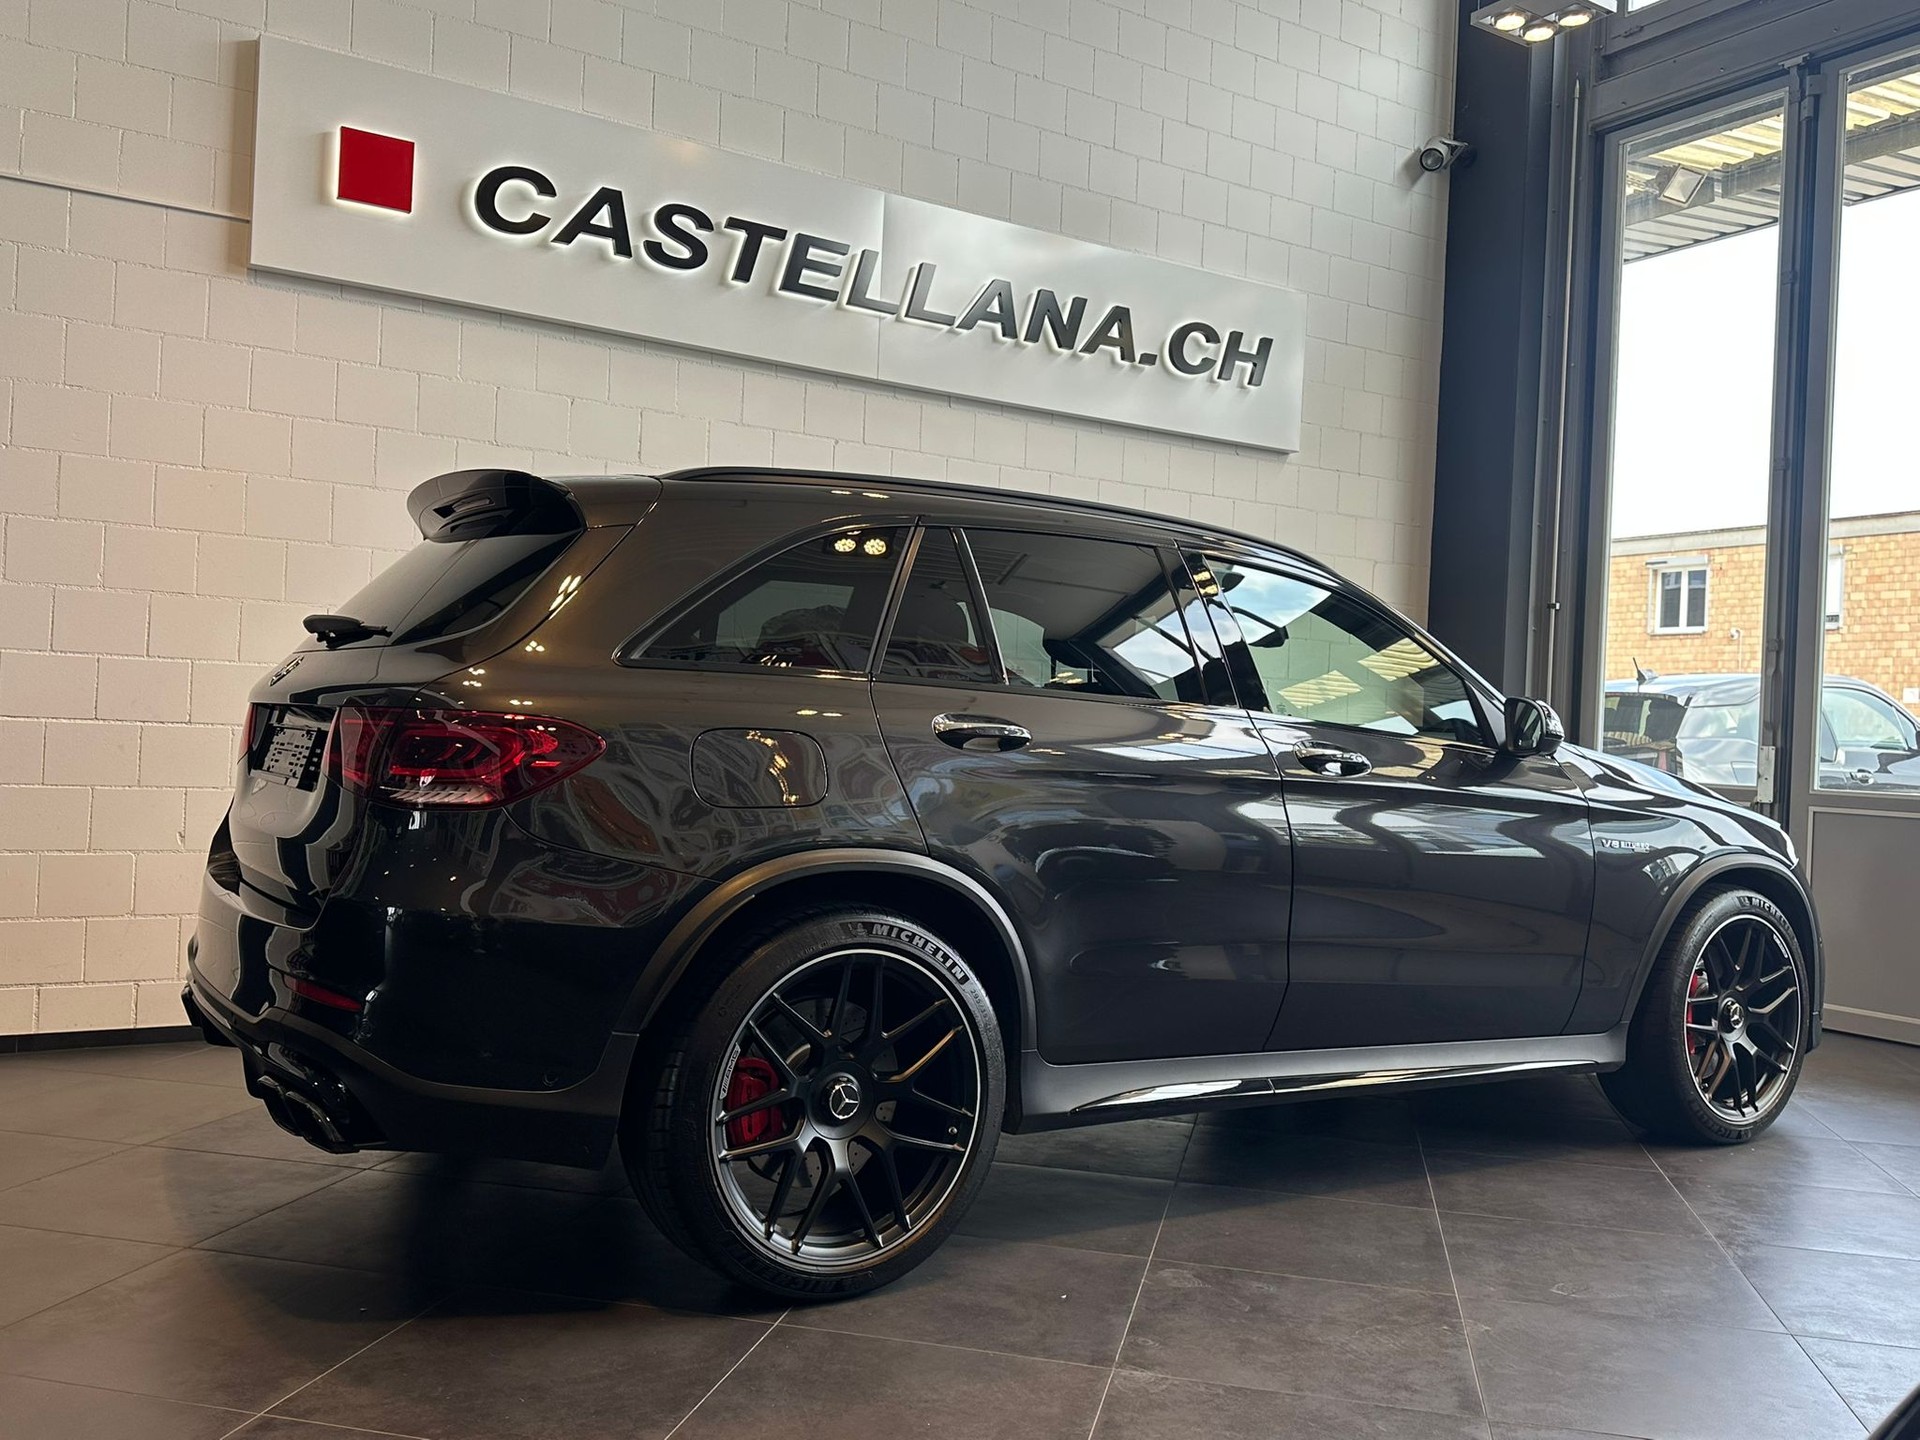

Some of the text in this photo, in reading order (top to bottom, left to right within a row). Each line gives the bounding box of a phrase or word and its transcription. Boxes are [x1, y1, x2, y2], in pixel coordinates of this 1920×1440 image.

[473, 164, 1275, 388] CASTELLANA.CH
[1601, 838, 1620, 849] V8
[872, 922, 966, 980] MICHELIN
